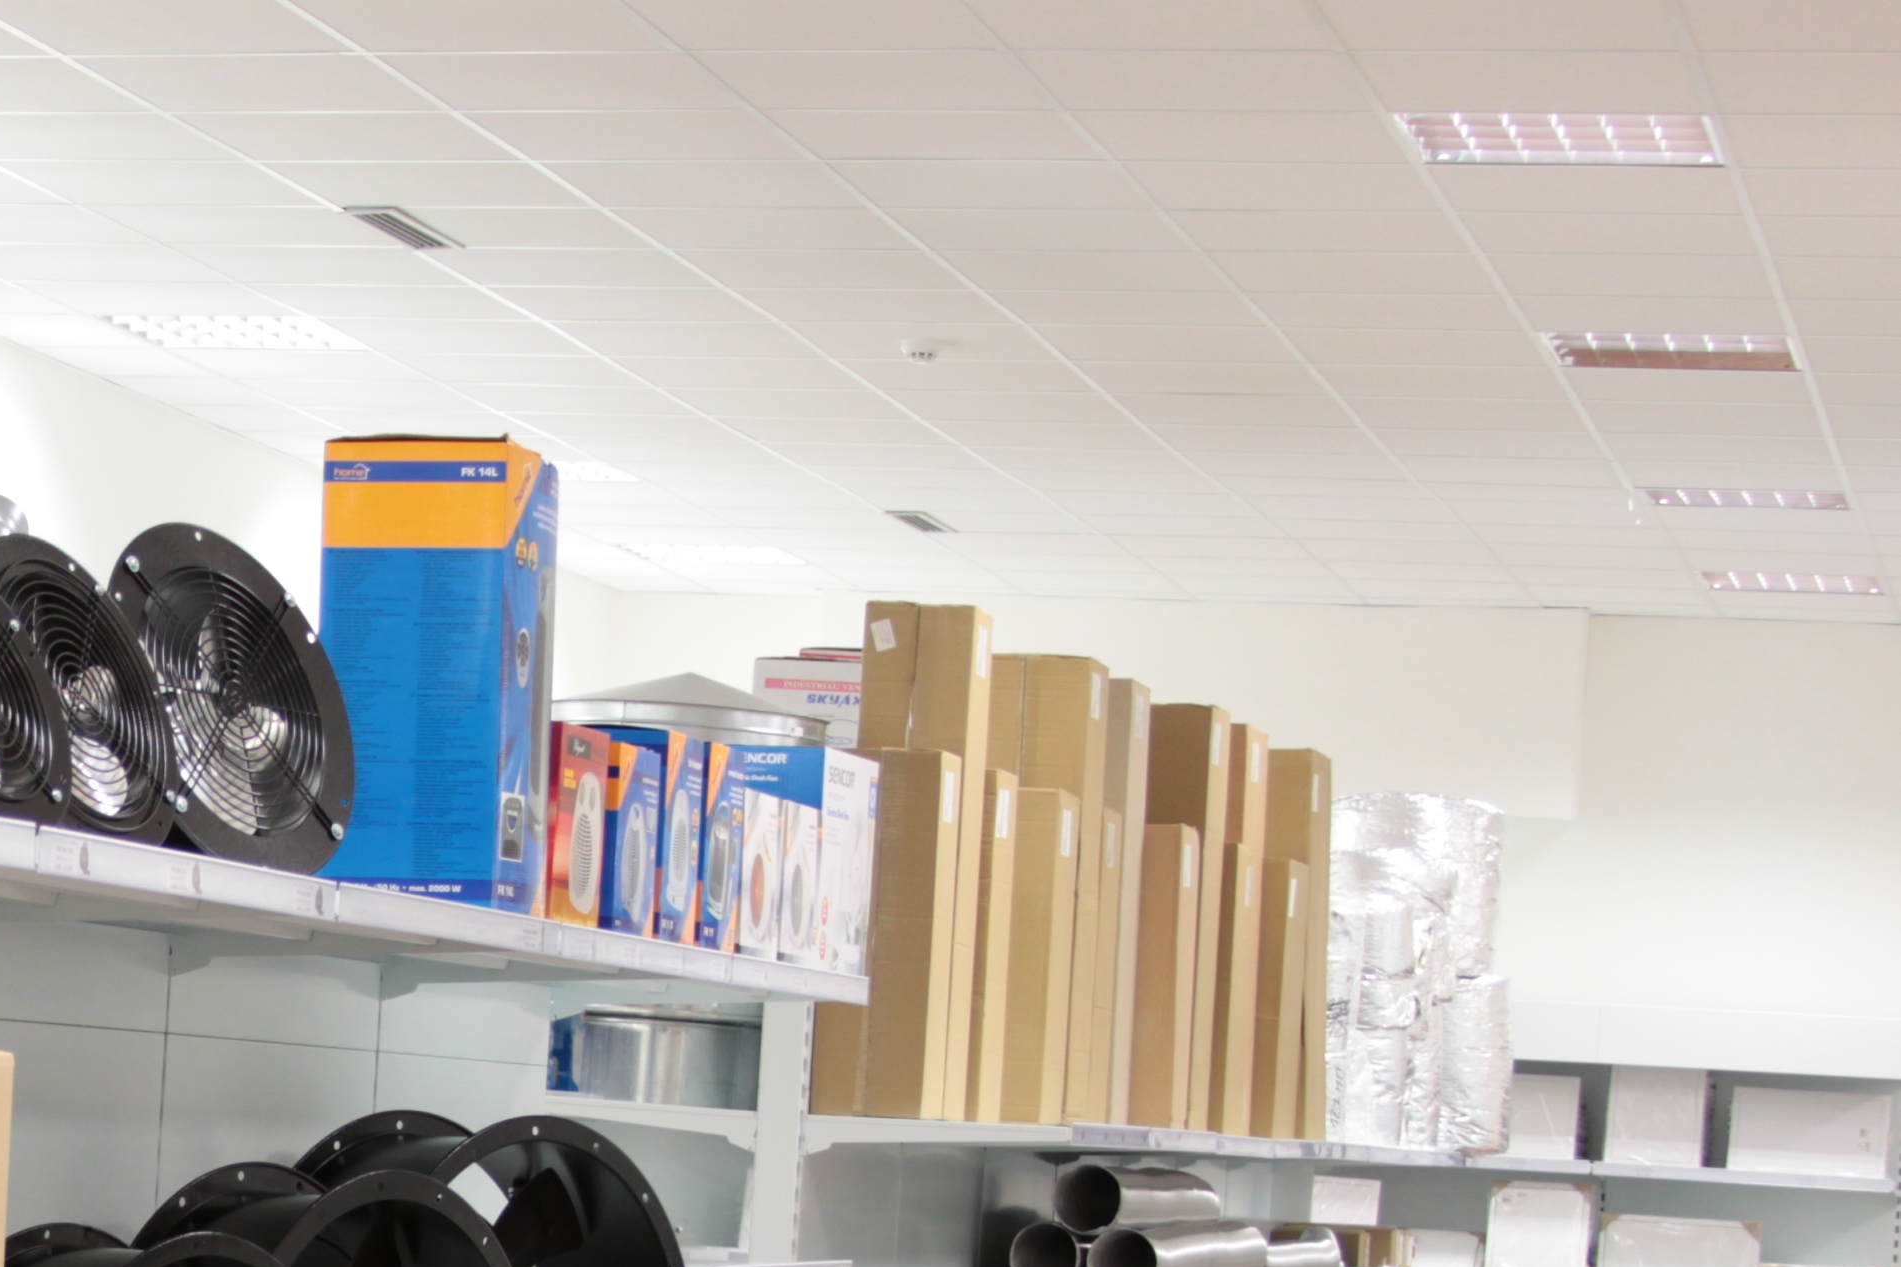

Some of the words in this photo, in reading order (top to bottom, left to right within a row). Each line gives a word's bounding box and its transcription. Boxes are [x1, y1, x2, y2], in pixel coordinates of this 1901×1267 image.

[460, 466, 476, 477] FK
[477, 466, 499, 478] 14L
[744, 752, 788, 765] ENCOR
[828, 765, 856, 788] SENCOR
[428, 885, 451, 893] 2000
[451, 885, 462, 893] W
